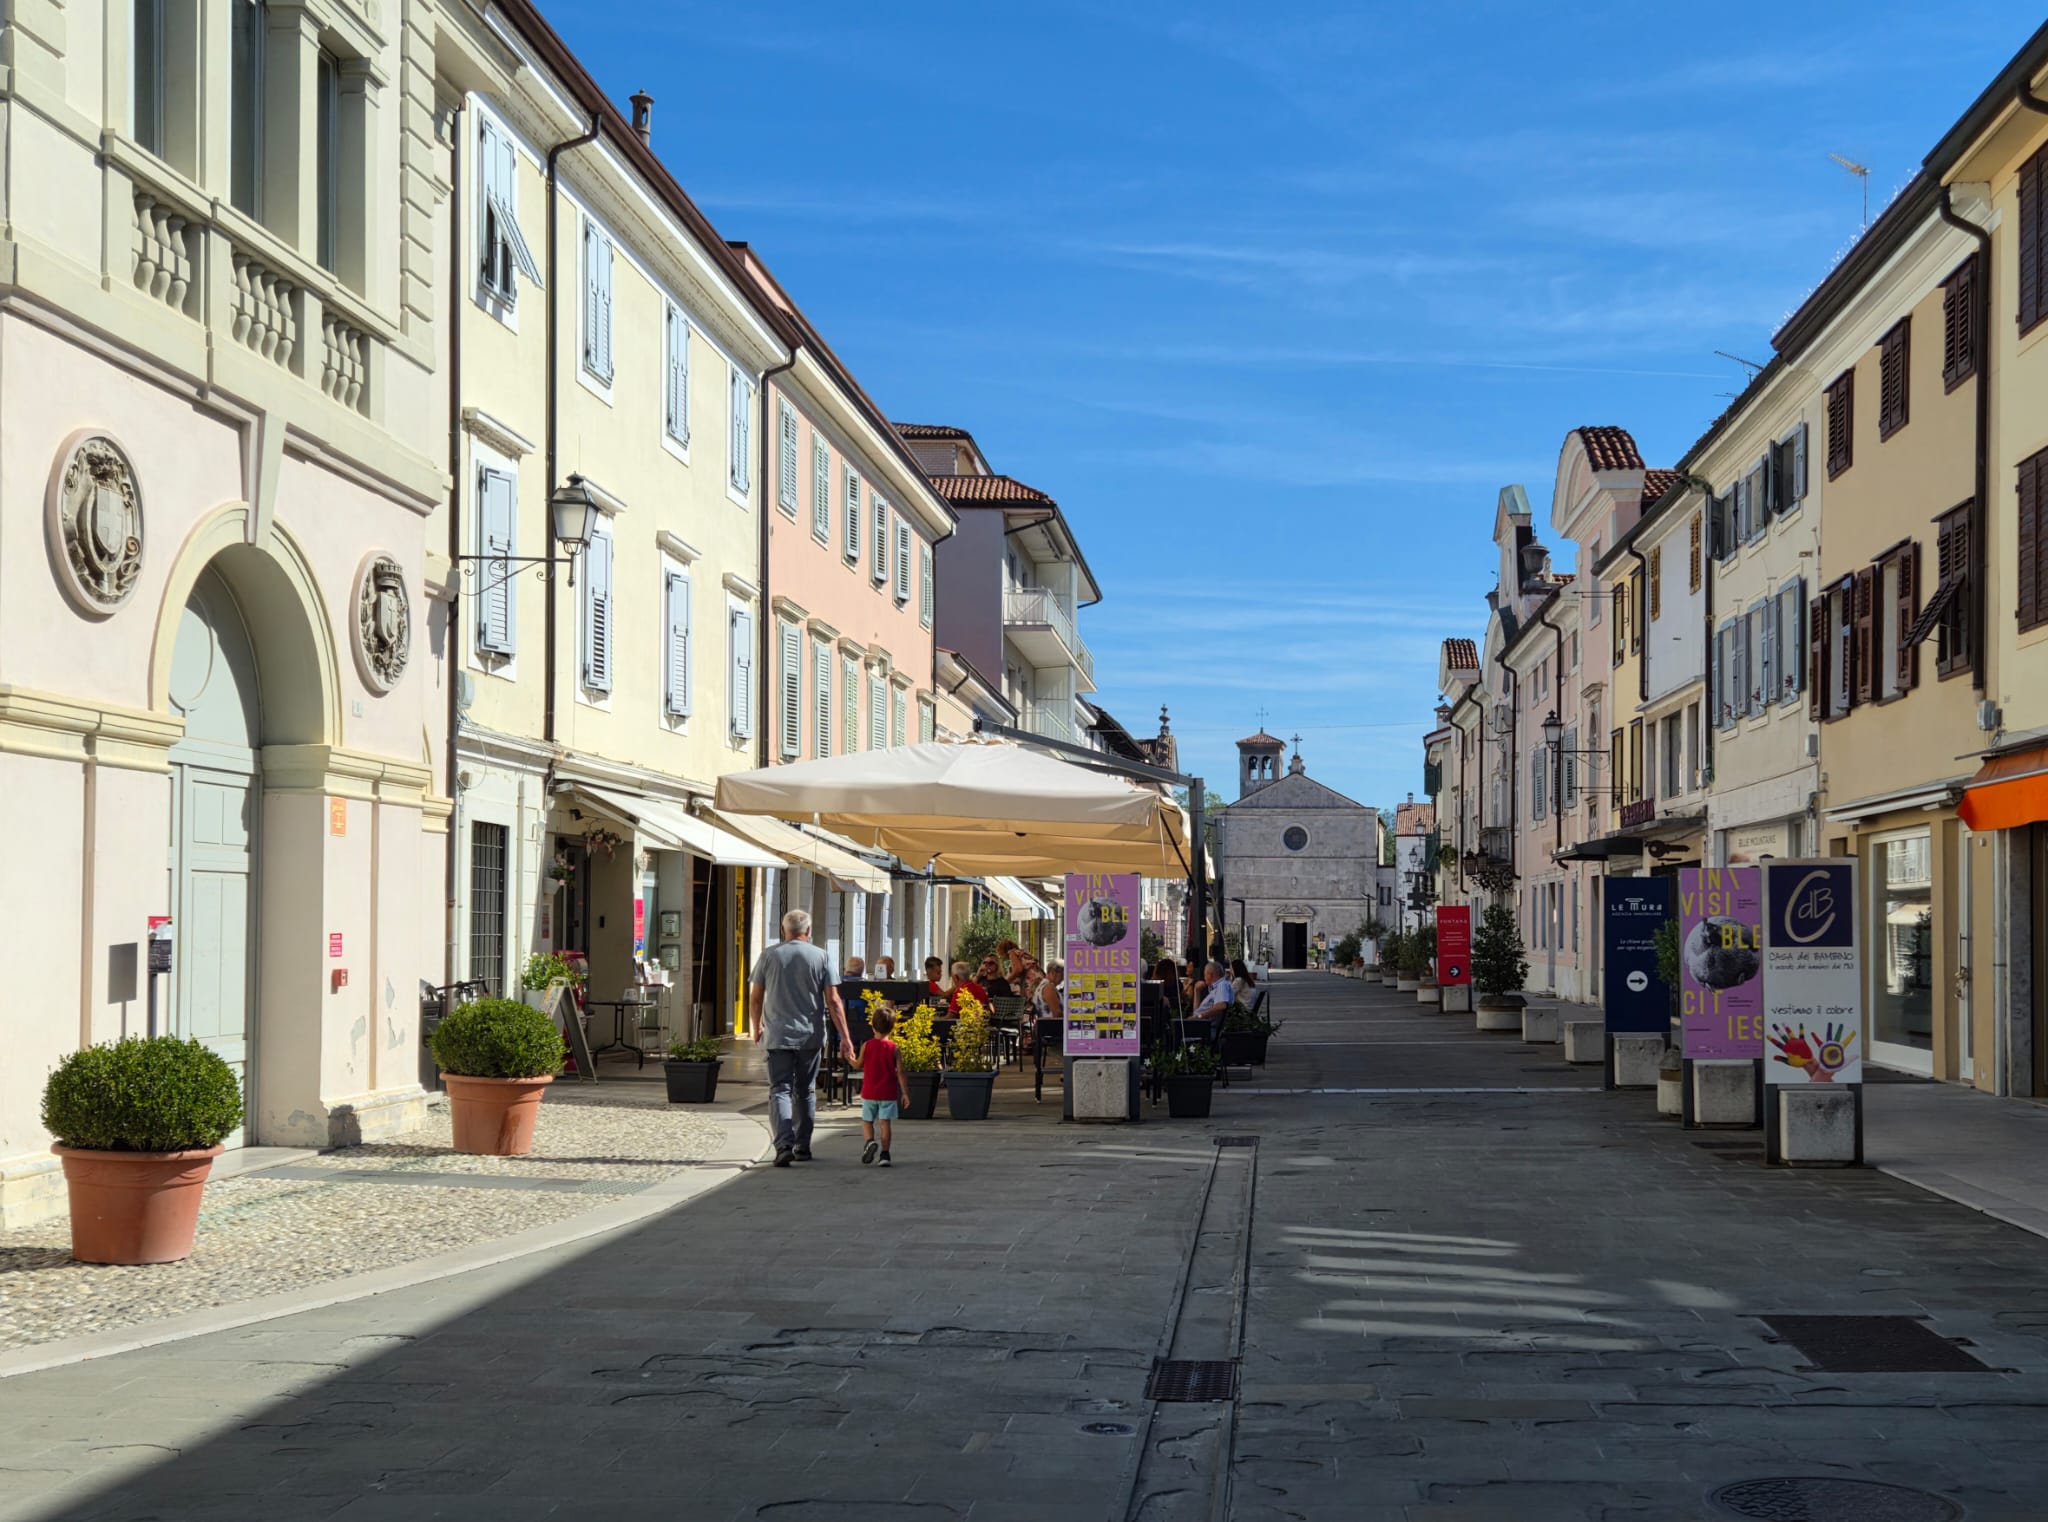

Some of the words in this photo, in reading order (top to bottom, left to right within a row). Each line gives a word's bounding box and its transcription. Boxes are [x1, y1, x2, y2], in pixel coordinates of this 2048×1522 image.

[1101, 905, 1129, 923] BLE
[1682, 892, 1732, 916] VISI
[1721, 924, 1760, 949] BLE
[1074, 949, 1130, 967] CITIES
[1684, 989, 1724, 1015] CIT
